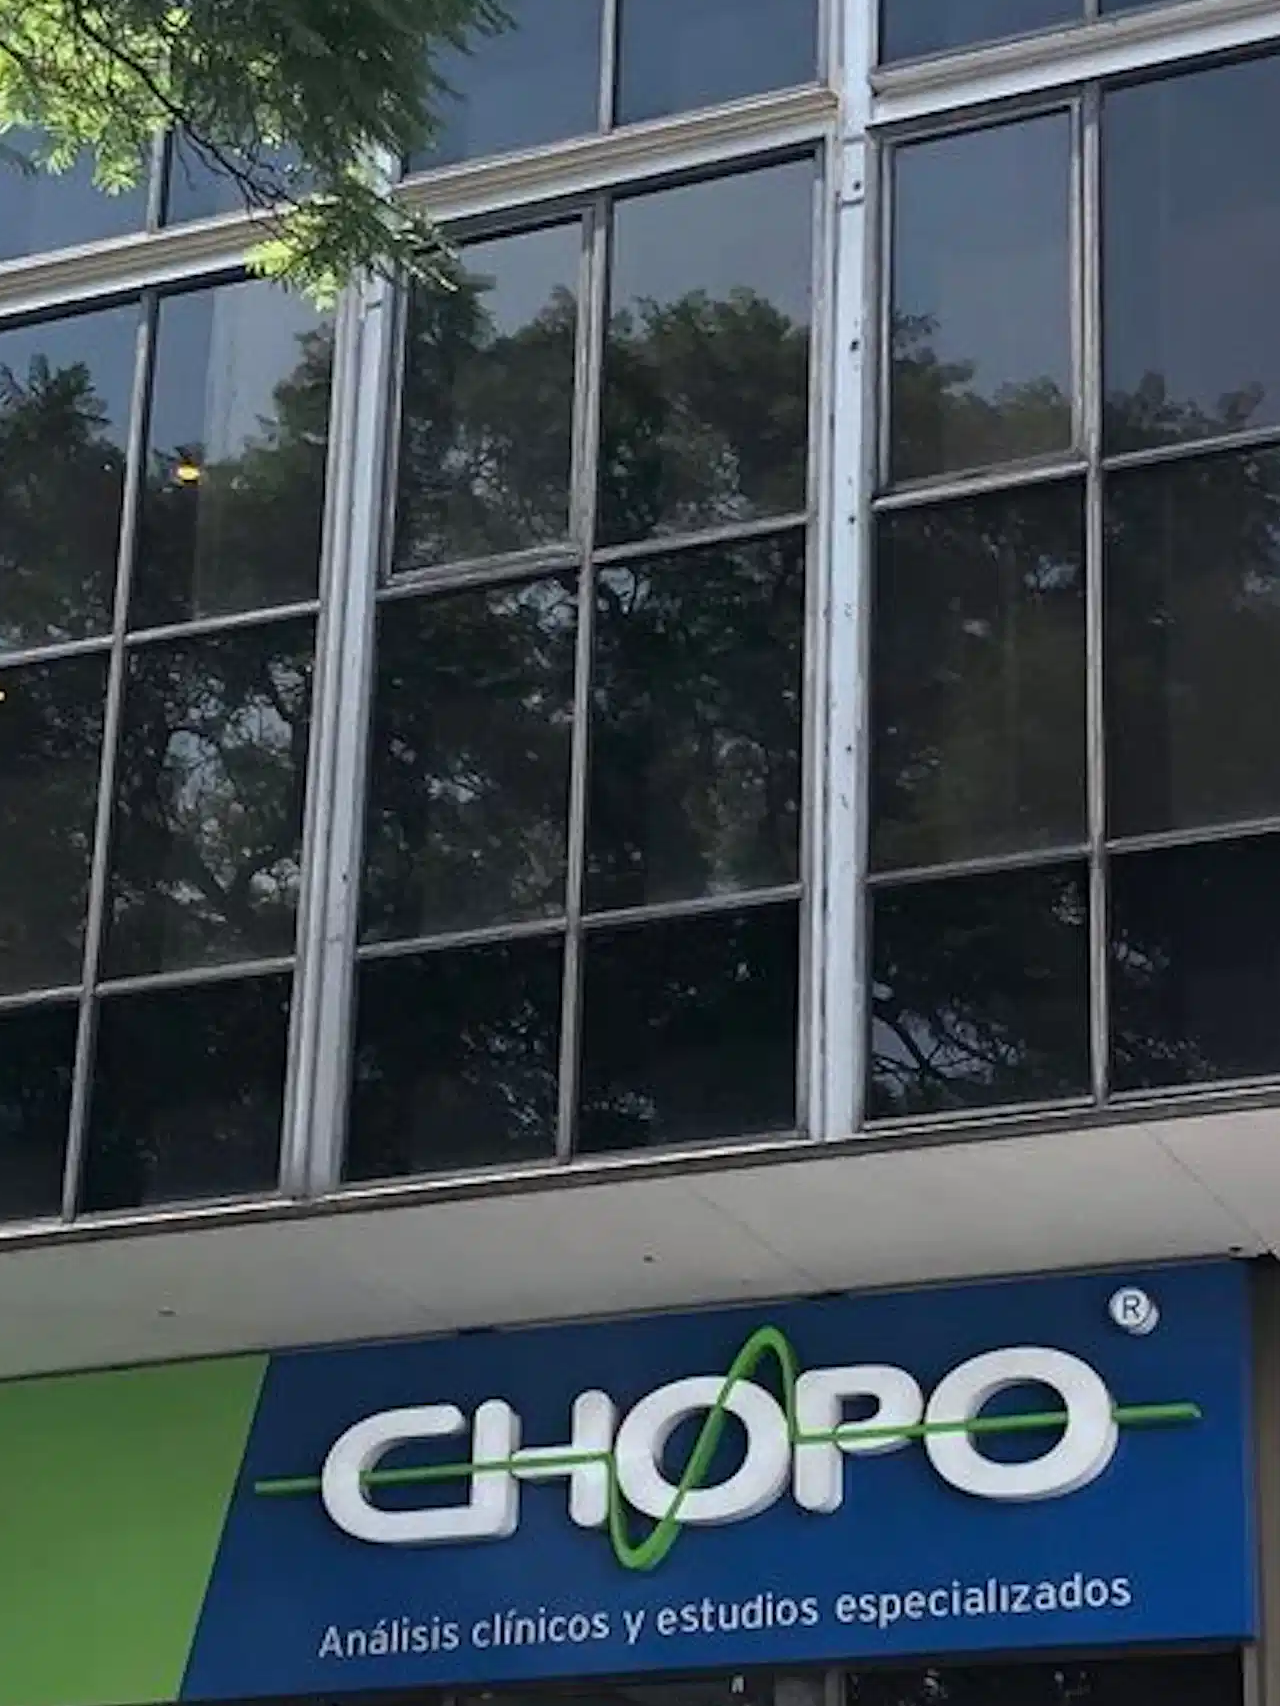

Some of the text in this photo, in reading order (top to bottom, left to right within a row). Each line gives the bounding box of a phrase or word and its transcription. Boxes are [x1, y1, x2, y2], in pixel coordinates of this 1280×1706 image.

[321, 1345, 1119, 1544] CHOPO
[319, 1573, 1132, 1659] Análisis clínicos y estudios especializados
